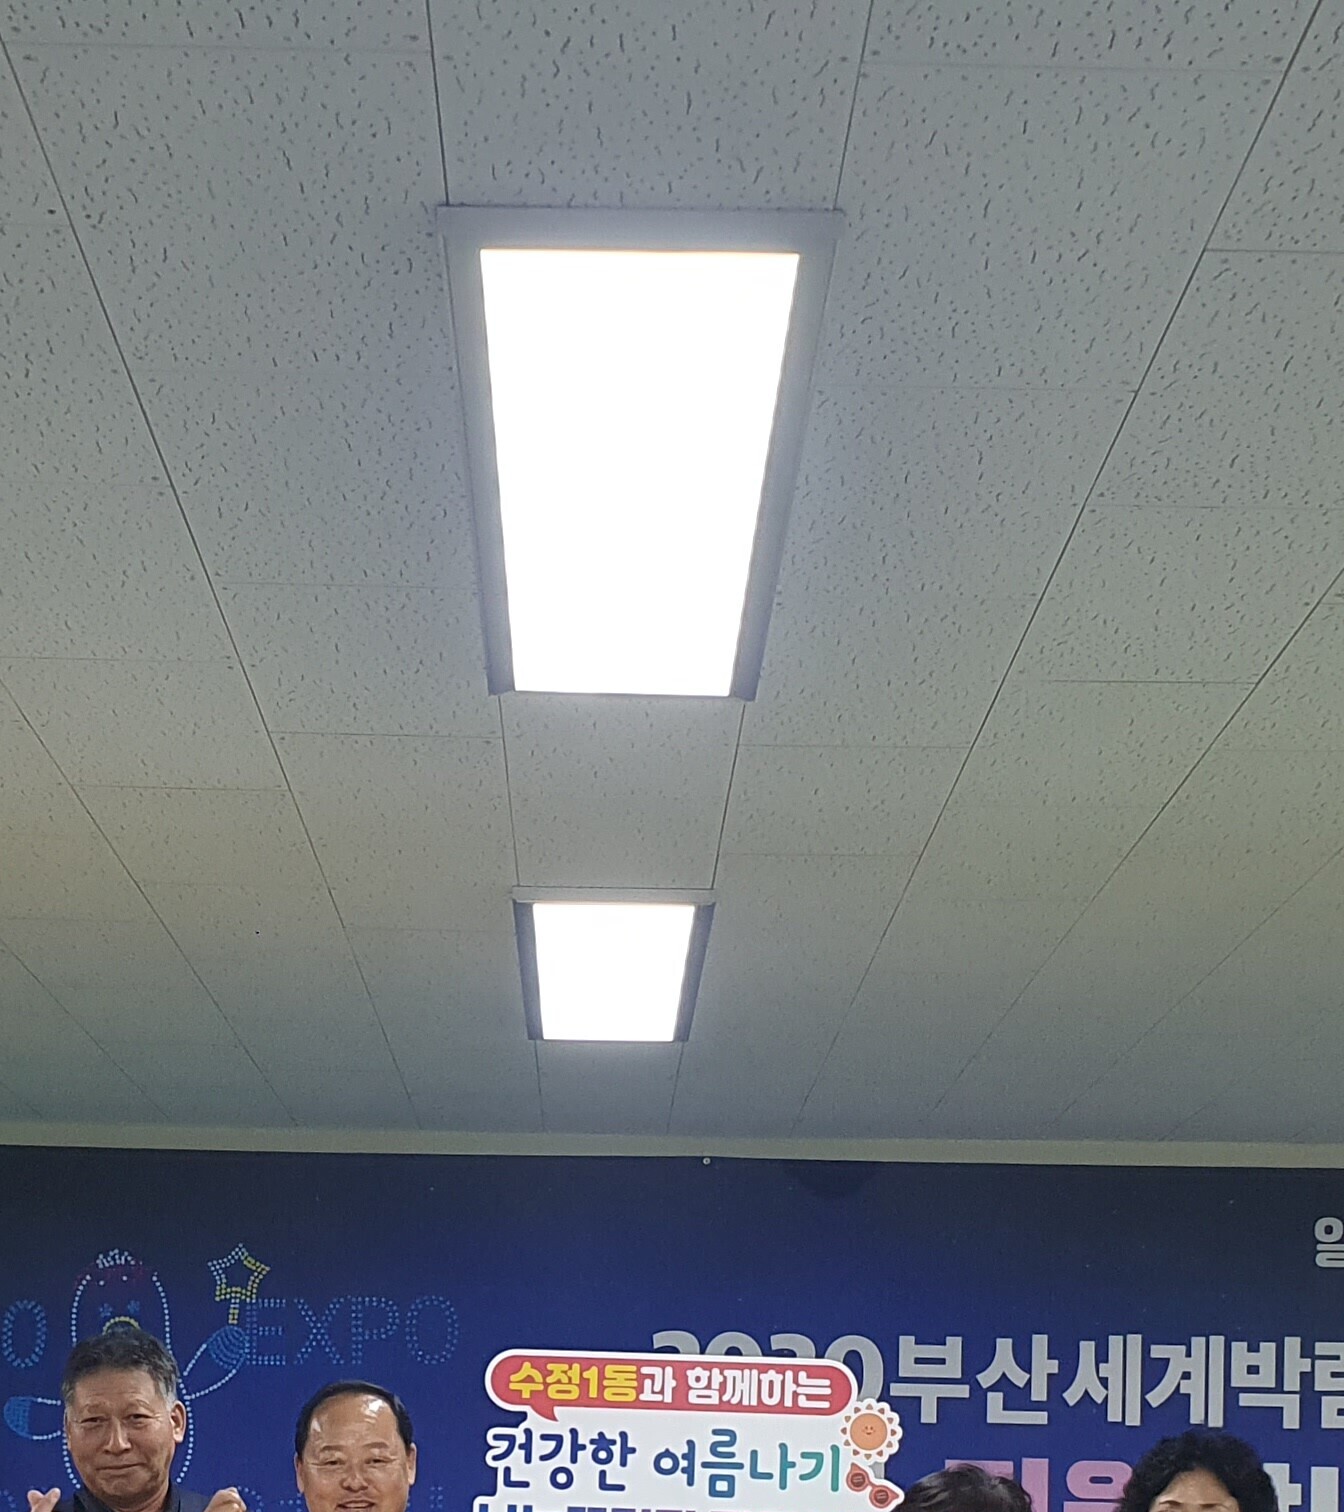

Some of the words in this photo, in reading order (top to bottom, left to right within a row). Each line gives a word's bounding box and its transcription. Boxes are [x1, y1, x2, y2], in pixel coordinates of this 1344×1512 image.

[244, 1296, 460, 1366] EXPO
[509, 1362, 676, 1403] 수정1동과
[687, 1368, 832, 1408] 함께하는
[491, 1429, 636, 1490] 건강한
[654, 1429, 840, 1498] 여름나기
